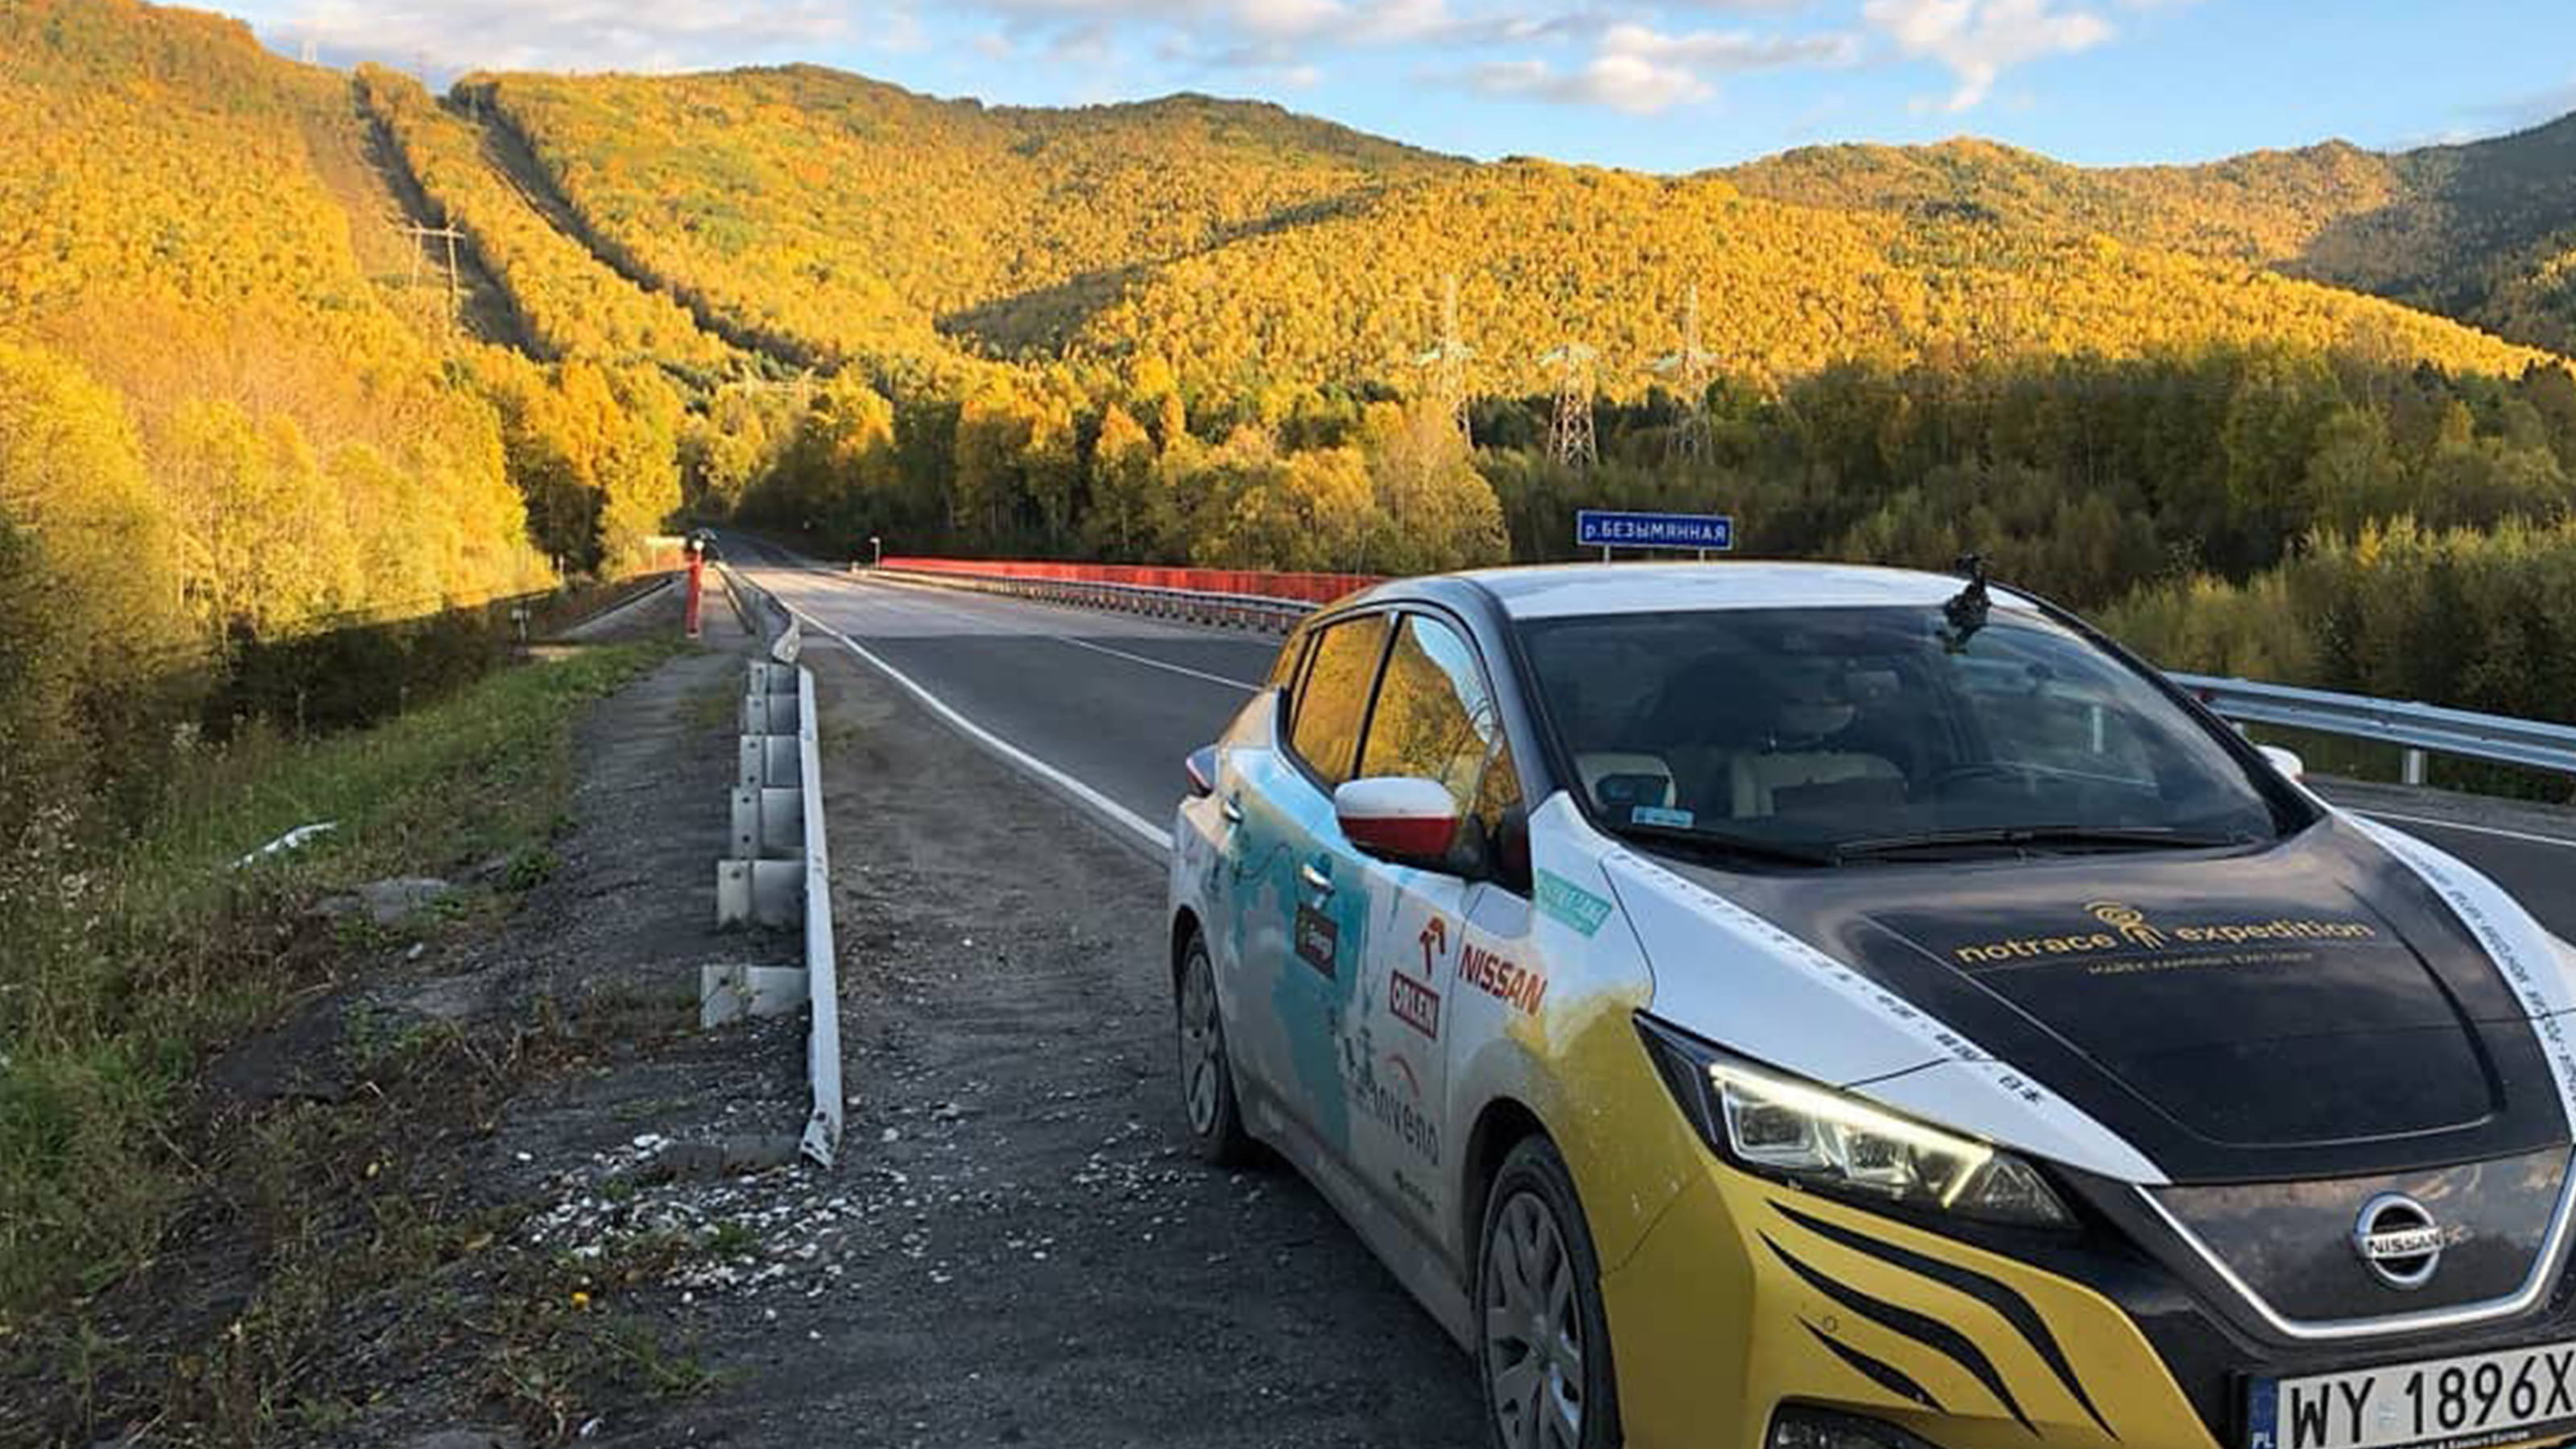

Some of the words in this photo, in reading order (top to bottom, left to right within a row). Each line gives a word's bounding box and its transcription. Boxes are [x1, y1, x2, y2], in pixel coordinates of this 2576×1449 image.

[1955, 933, 2118, 964] notrace
[2174, 919, 2376, 944] expedition
[1392, 976, 1437, 1034] ORLEN
[1458, 944, 1548, 1017] NISSAN
[2368, 1233, 2442, 1253] NISSAN
[2290, 1377, 2376, 1449] WY
[2404, 1350, 2575, 1435] 1896X
[2252, 1432, 2274, 1448] PL
